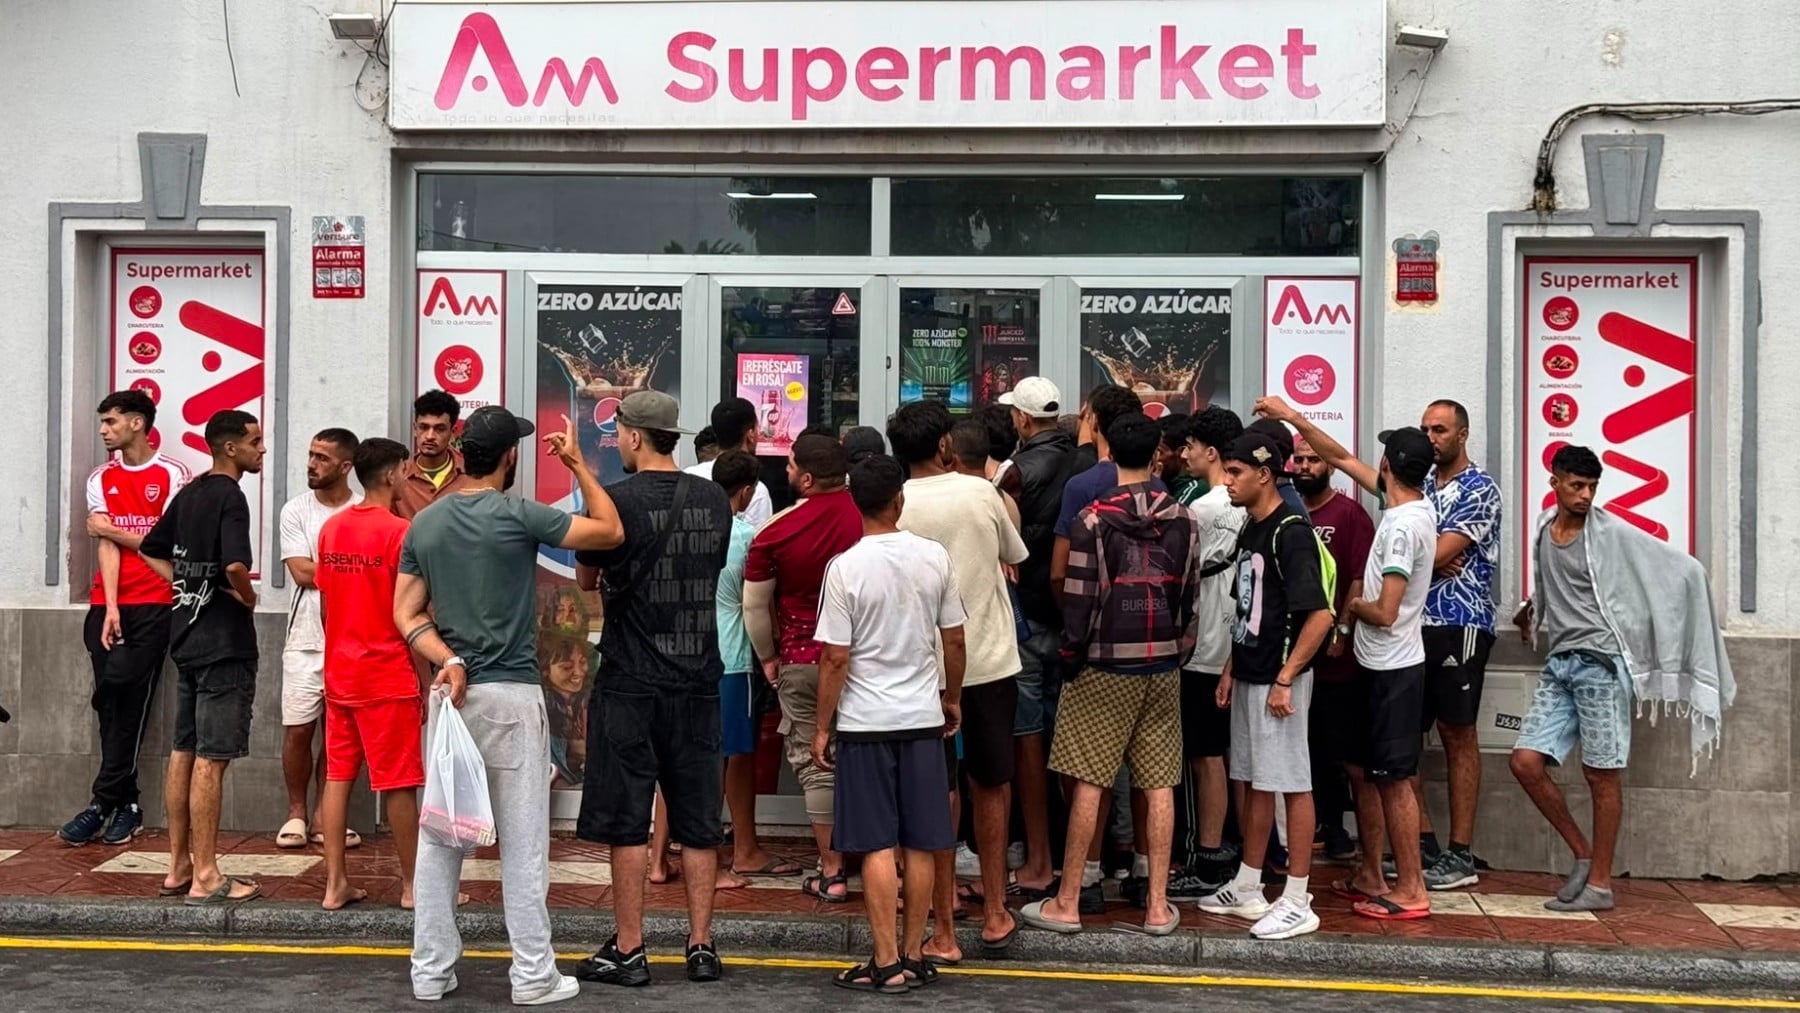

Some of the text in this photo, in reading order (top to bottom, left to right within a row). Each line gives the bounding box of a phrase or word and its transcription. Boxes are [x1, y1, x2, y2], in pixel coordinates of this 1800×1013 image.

[664, 25, 1322, 121] Supermarket
[315, 249, 361, 261] Alarma
[127, 261, 252, 281] Supermarket
[1400, 263, 1434, 272] Alarma
[1540, 271, 1679, 292] Supermarket
[538, 286, 682, 311] ZERO AZÚCAR
[1080, 289, 1231, 314] ZERO AZÚCAR
[912, 327, 957, 338] ZERO AZÚCAR
[912, 339, 962, 348] 100% MONSTER
[743, 358, 803, 374] ¡REFRÉSCATE
[743, 374, 785, 387] EN ROSA!
[683, 508, 715, 530] ARE
[683, 578, 714, 602] THE
[655, 633, 704, 656] HEART
